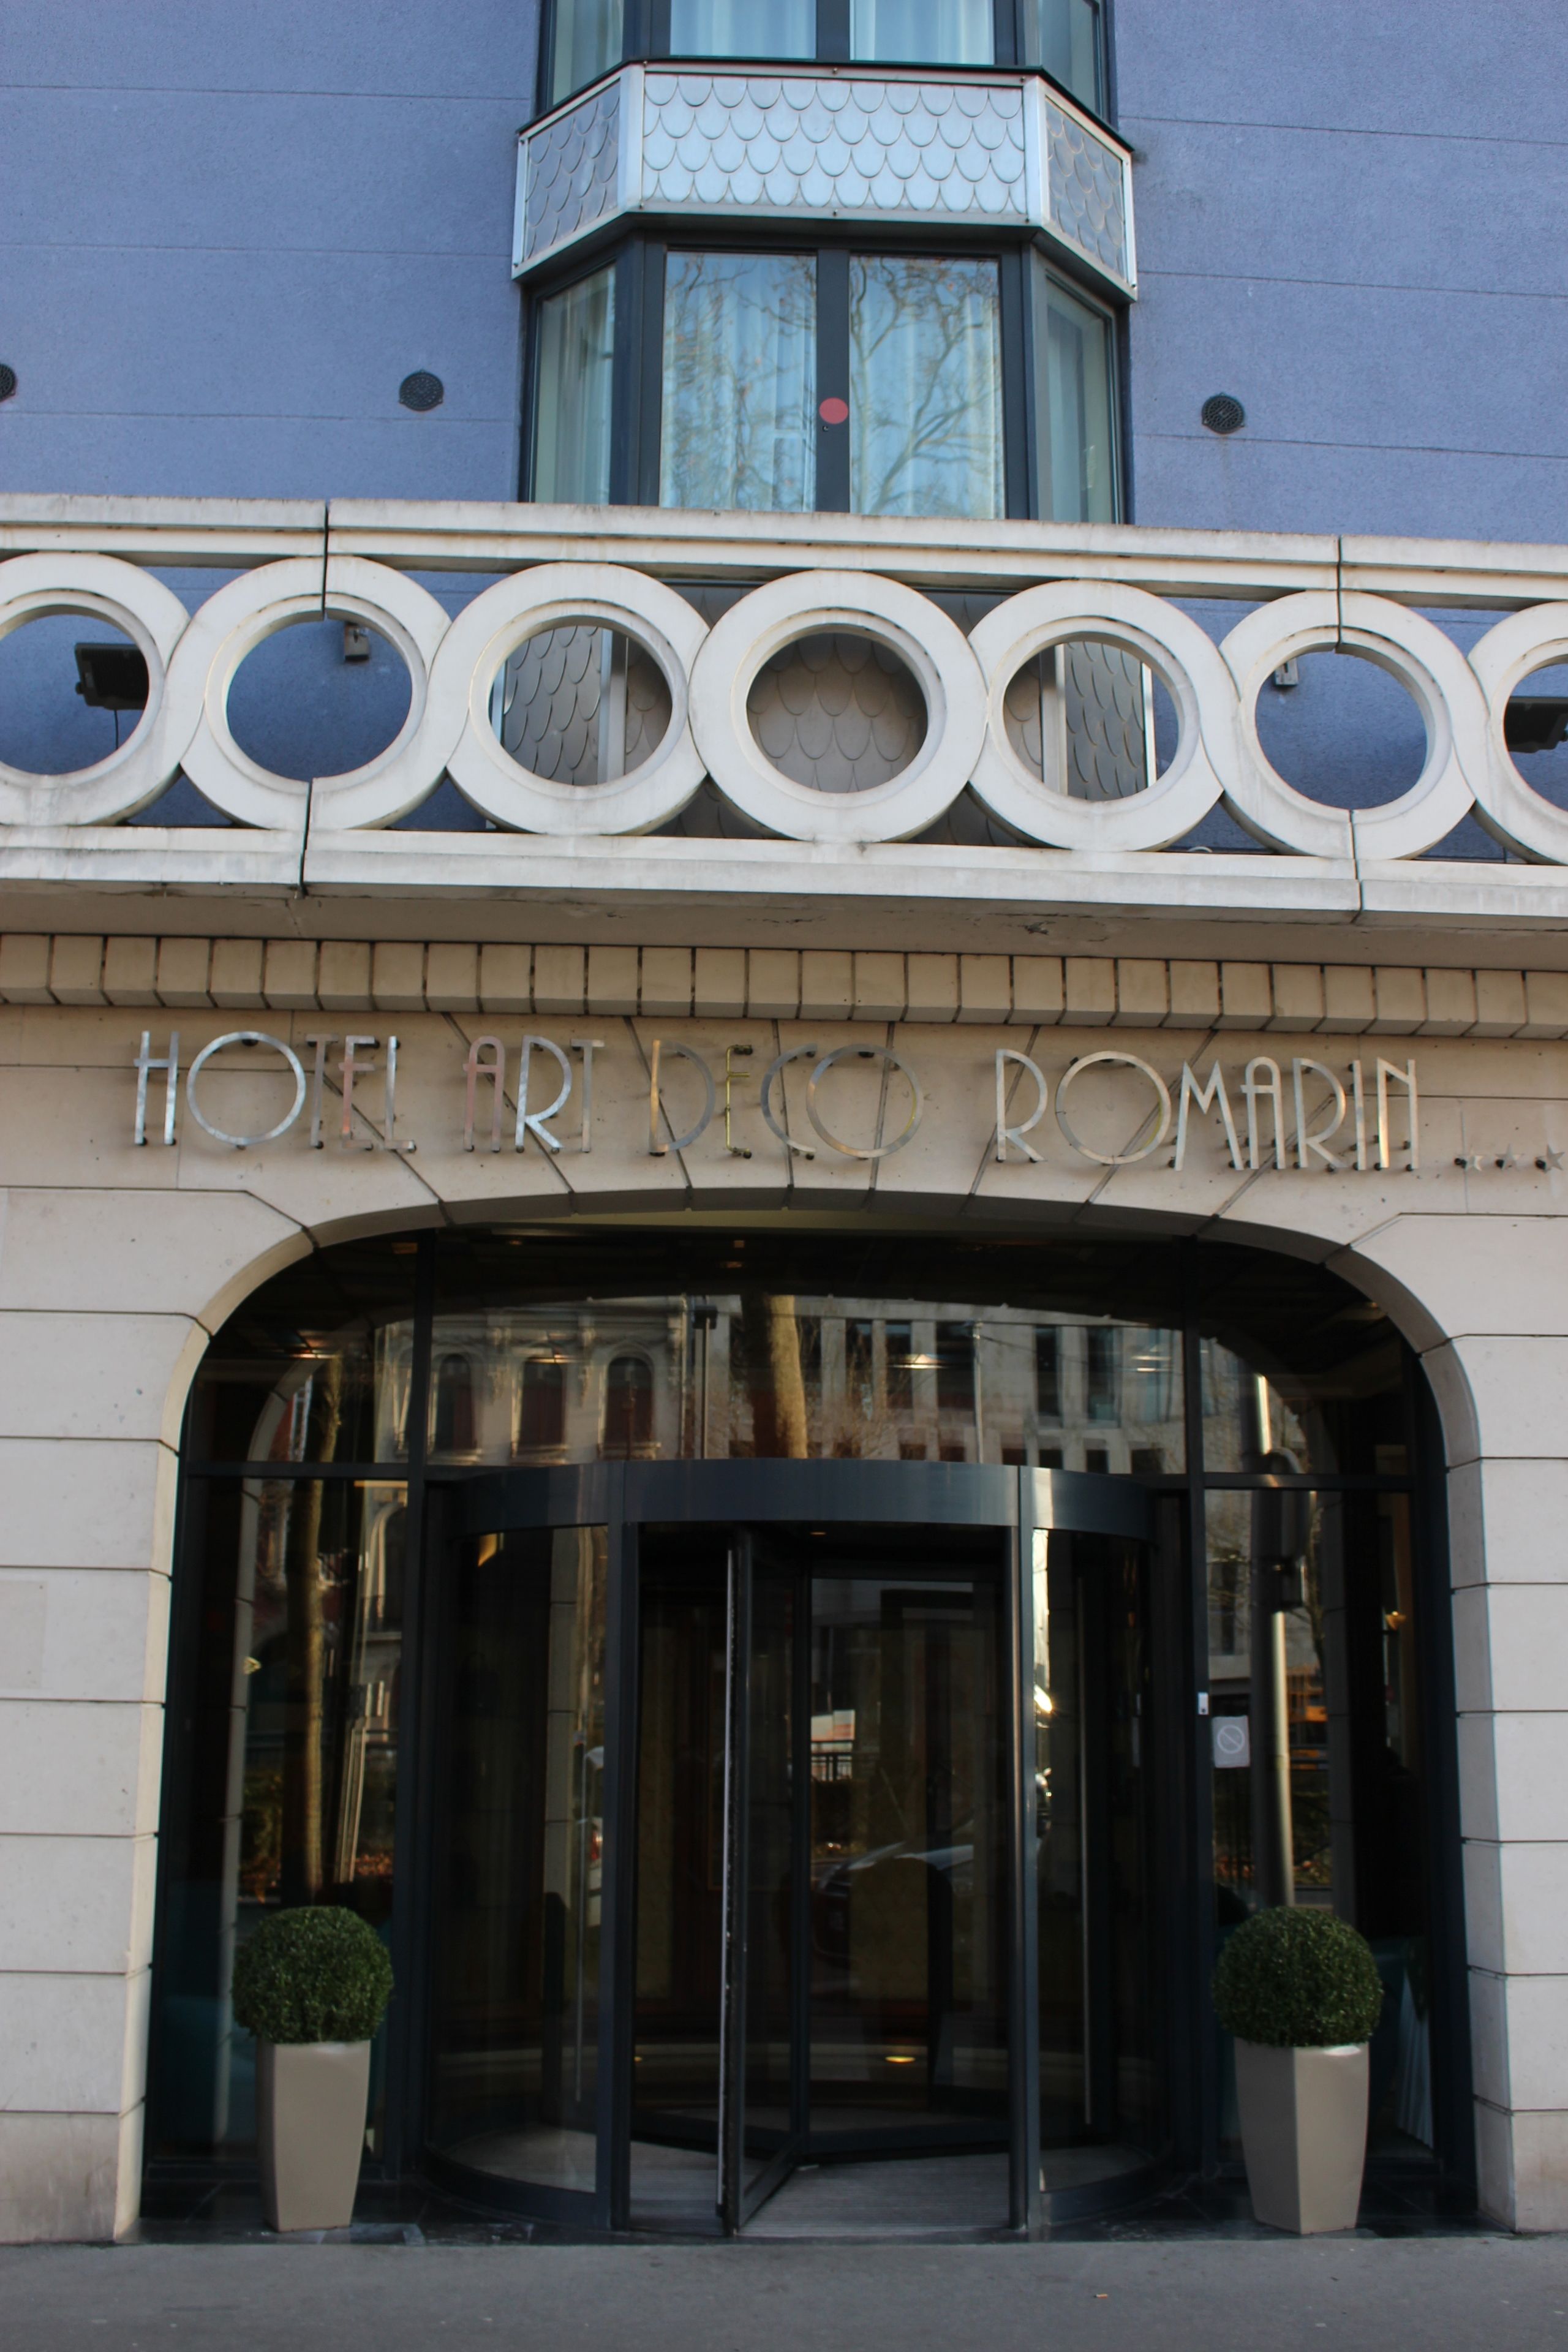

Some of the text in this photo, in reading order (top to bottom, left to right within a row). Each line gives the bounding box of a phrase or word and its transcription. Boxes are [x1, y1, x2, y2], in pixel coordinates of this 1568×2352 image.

[134, 1031, 1419, 1171] HOTEL ART DECO ROMARIN
